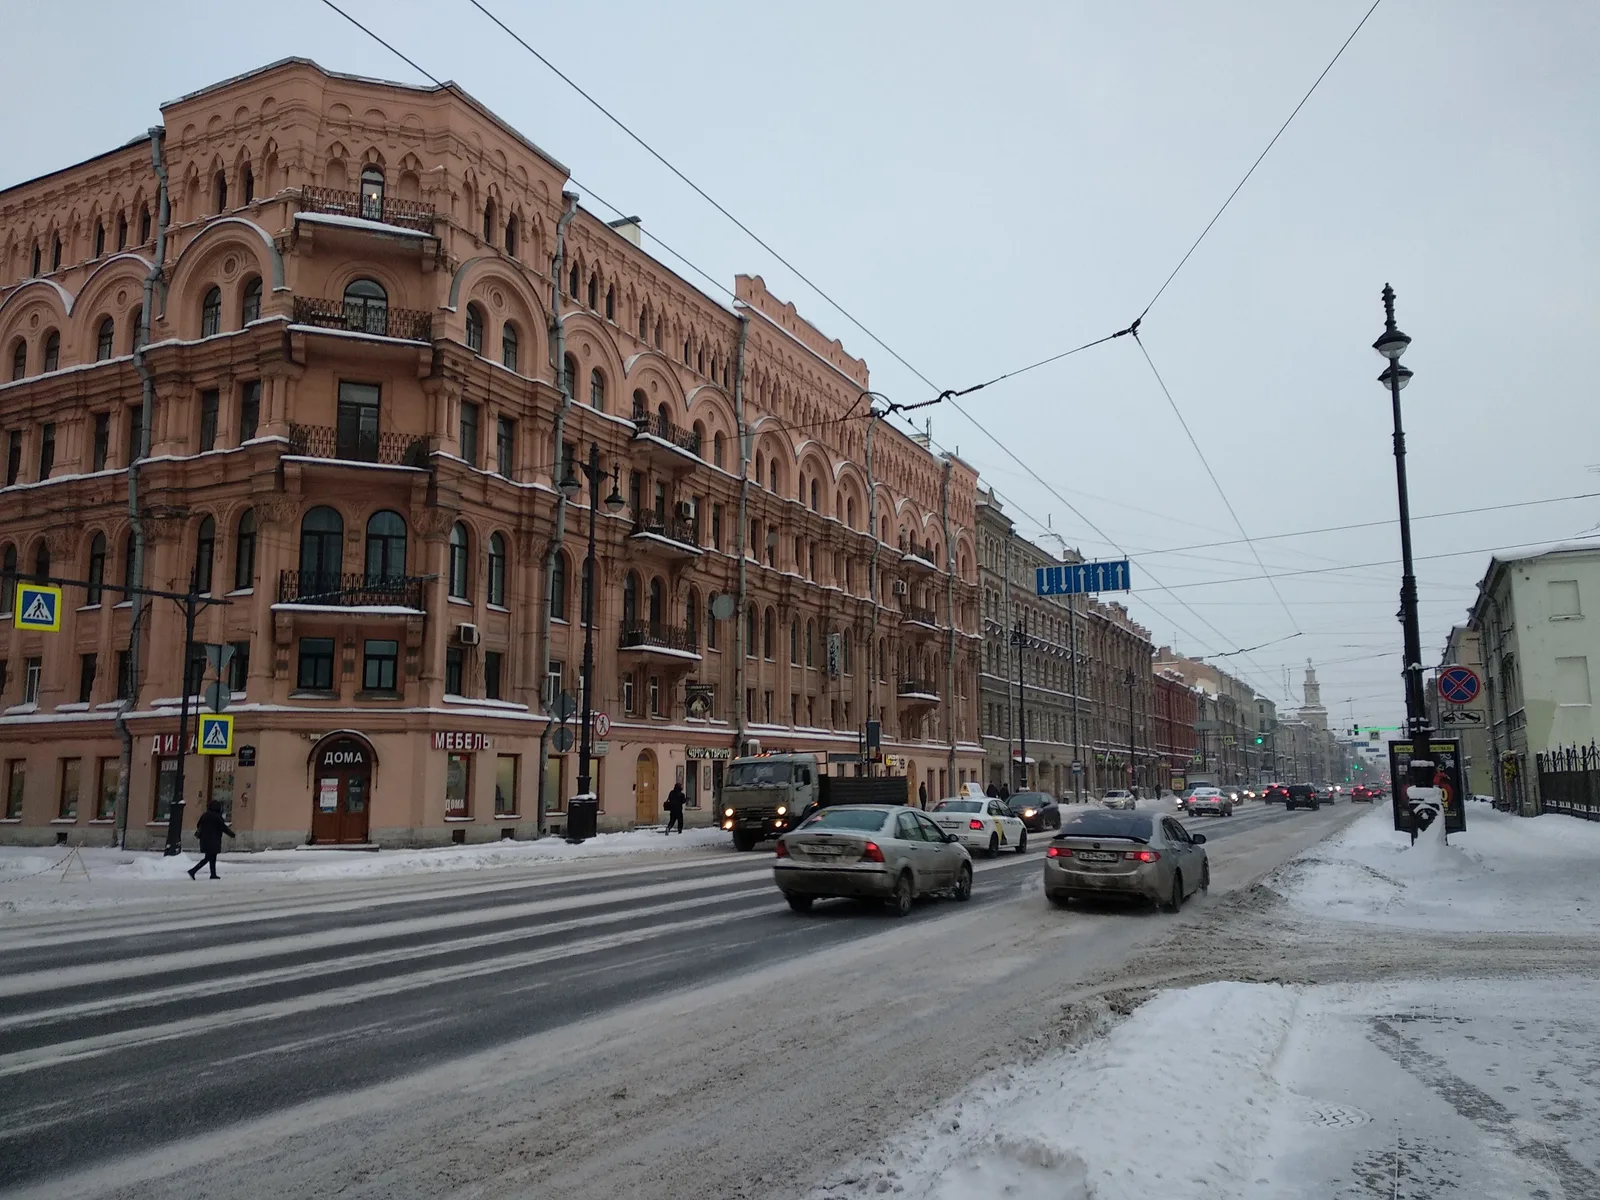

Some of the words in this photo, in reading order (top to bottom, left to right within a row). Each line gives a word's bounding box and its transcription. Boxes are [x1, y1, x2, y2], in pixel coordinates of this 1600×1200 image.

[435, 731, 491, 749] МЕБЕЛЬ
[324, 751, 363, 765] ДОМА
[215, 759, 235, 773] СВЕТ
[445, 799, 465, 813] ДОМА
